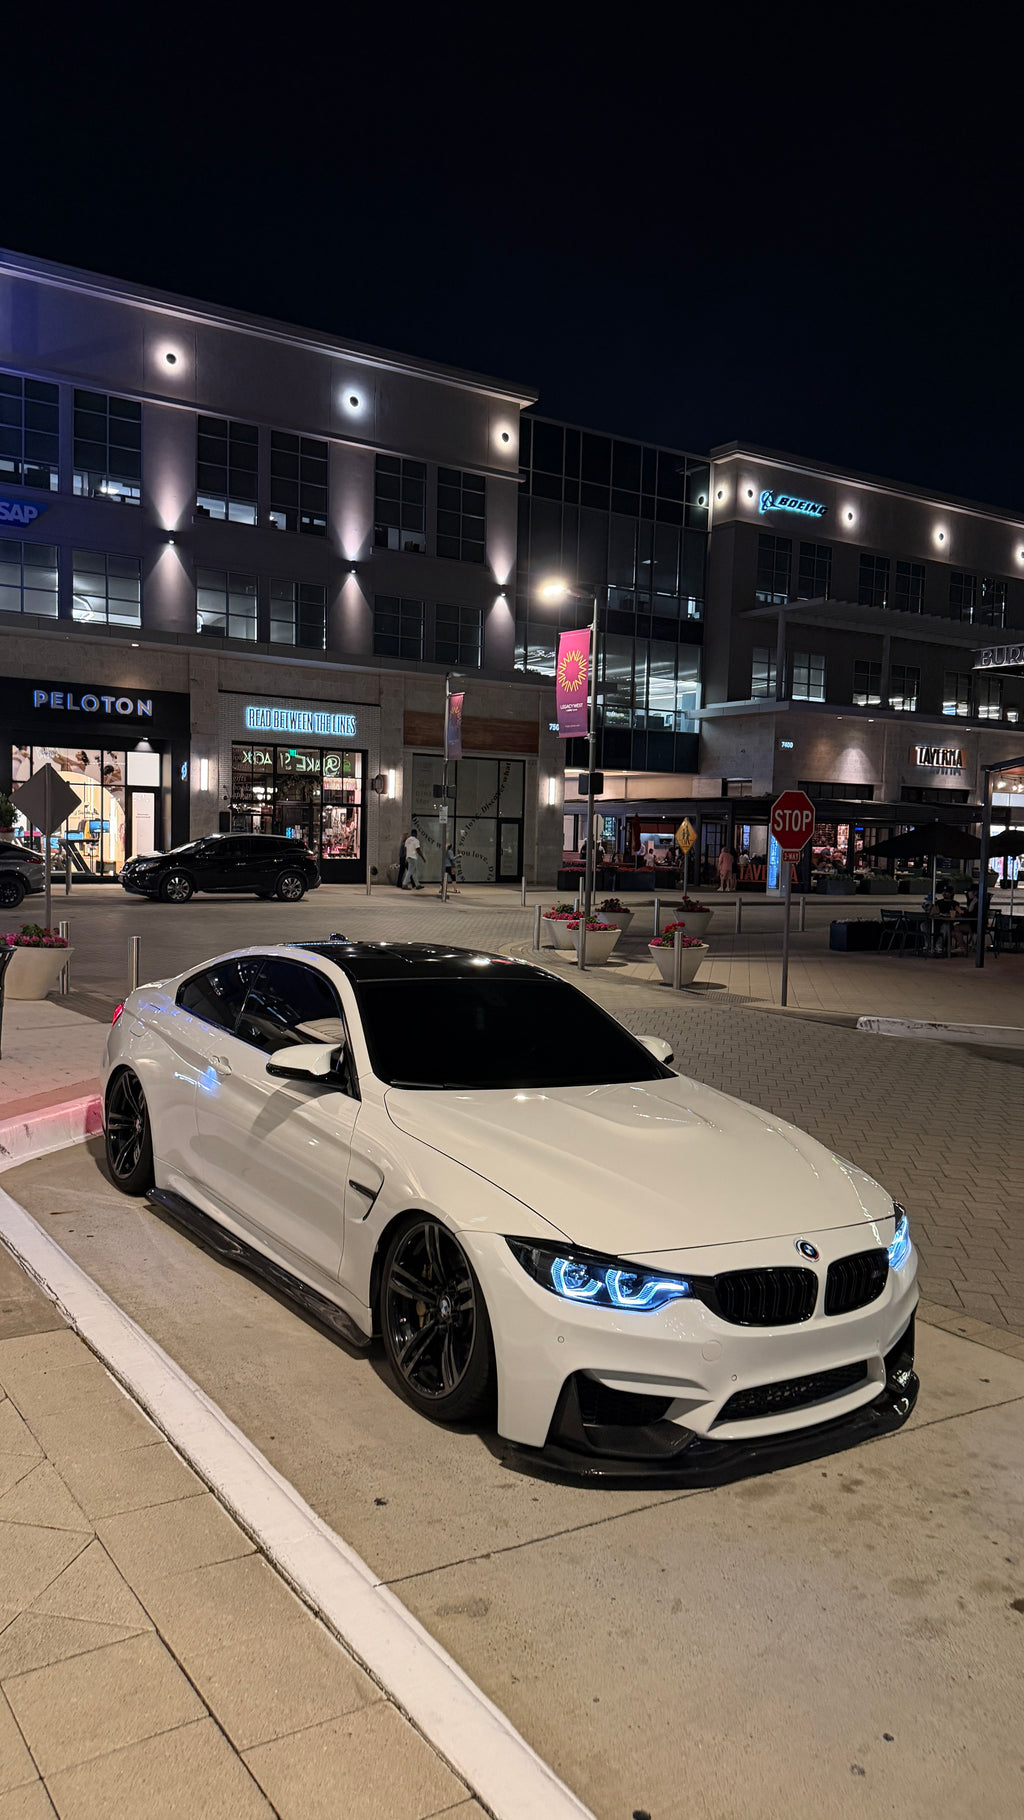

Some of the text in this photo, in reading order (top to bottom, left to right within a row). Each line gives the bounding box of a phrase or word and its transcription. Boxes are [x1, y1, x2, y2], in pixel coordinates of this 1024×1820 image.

[0, 502, 38, 523] SAP
[779, 497, 828, 515] BOEING
[981, 647, 1024, 666] BUR
[33, 690, 153, 717] PELOTON
[249, 708, 356, 735] READ BETWEEN THE LINES
[915, 746, 963, 768] TAVERNA
[774, 810, 812, 832] STOP
